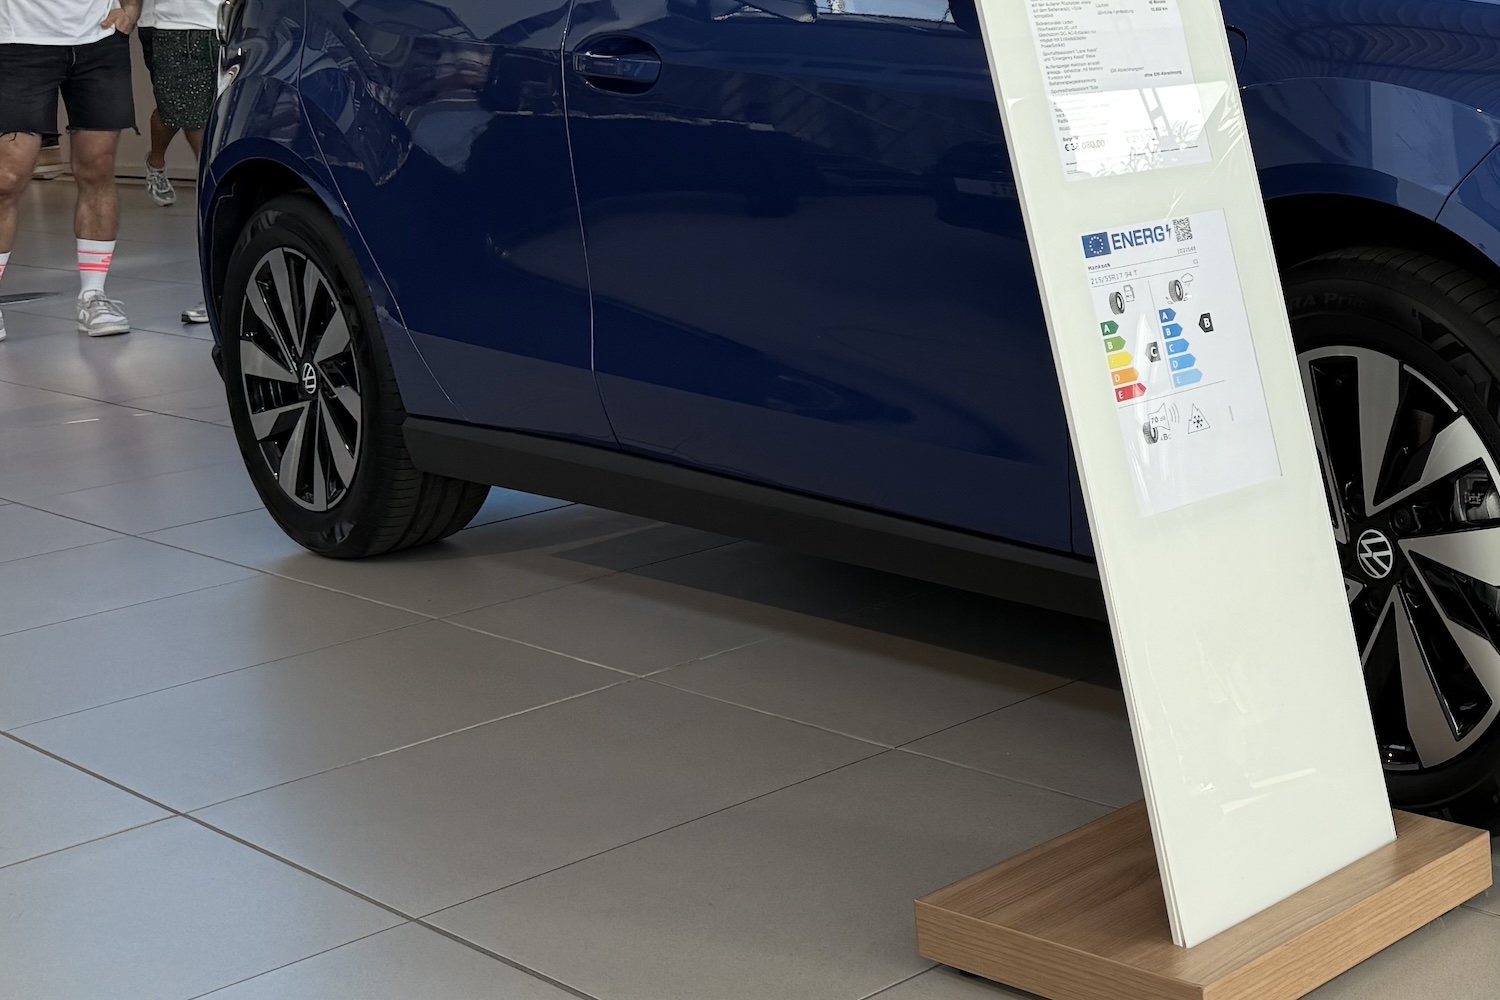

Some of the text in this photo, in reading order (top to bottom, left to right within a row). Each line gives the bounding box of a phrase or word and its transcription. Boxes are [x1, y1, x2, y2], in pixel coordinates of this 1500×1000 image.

[1111, 225, 1166, 250] ENERG
[1162, 312, 1169, 320] A
[1203, 317, 1211, 329] B
[1103, 324, 1111, 333] A
[1165, 328, 1172, 337] B
[1107, 341, 1114, 350] B
[1150, 346, 1158, 358] C
[1118, 391, 1124, 400] E
